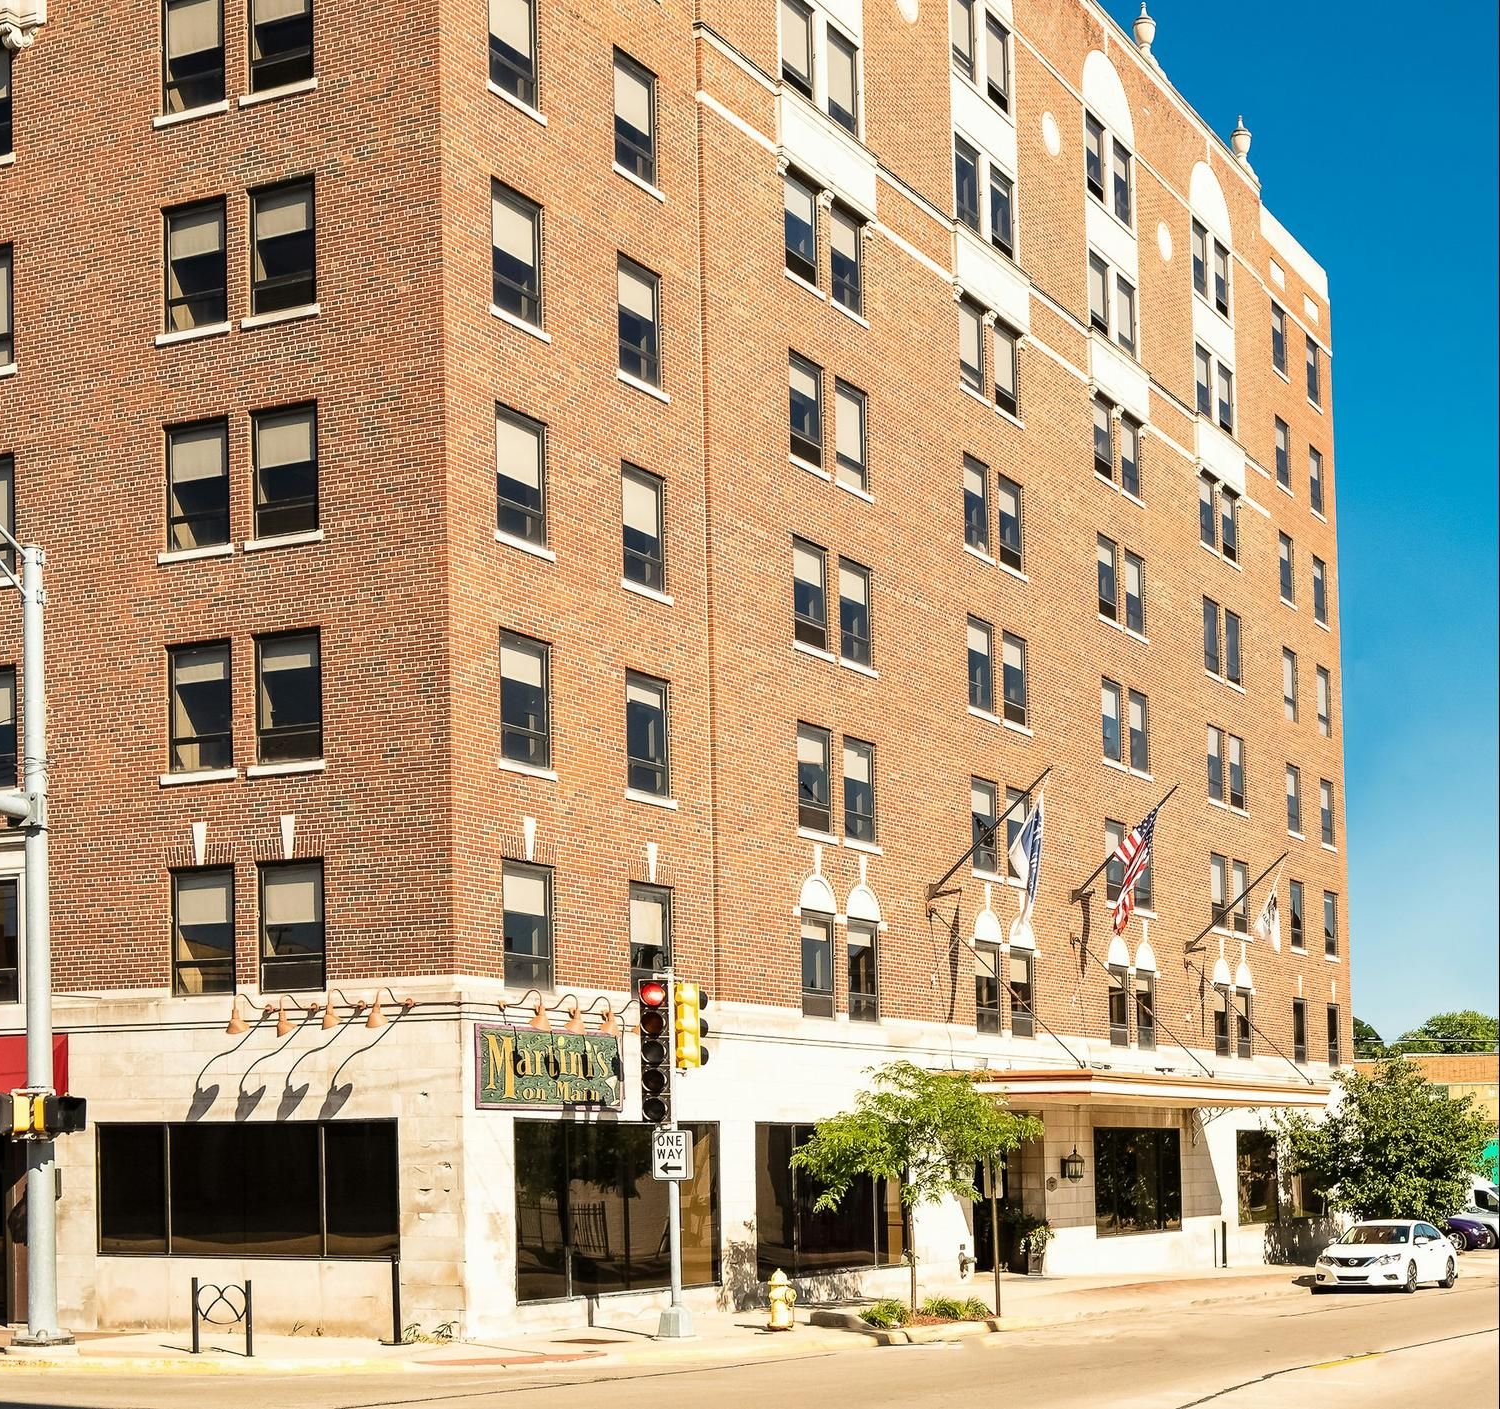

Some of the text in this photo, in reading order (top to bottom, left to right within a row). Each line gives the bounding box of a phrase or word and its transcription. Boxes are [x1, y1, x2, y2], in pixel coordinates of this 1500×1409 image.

[522, 1080, 601, 1103] on Main
[657, 1135, 683, 1147] ONE
[657, 1148, 683, 1160] WAY
